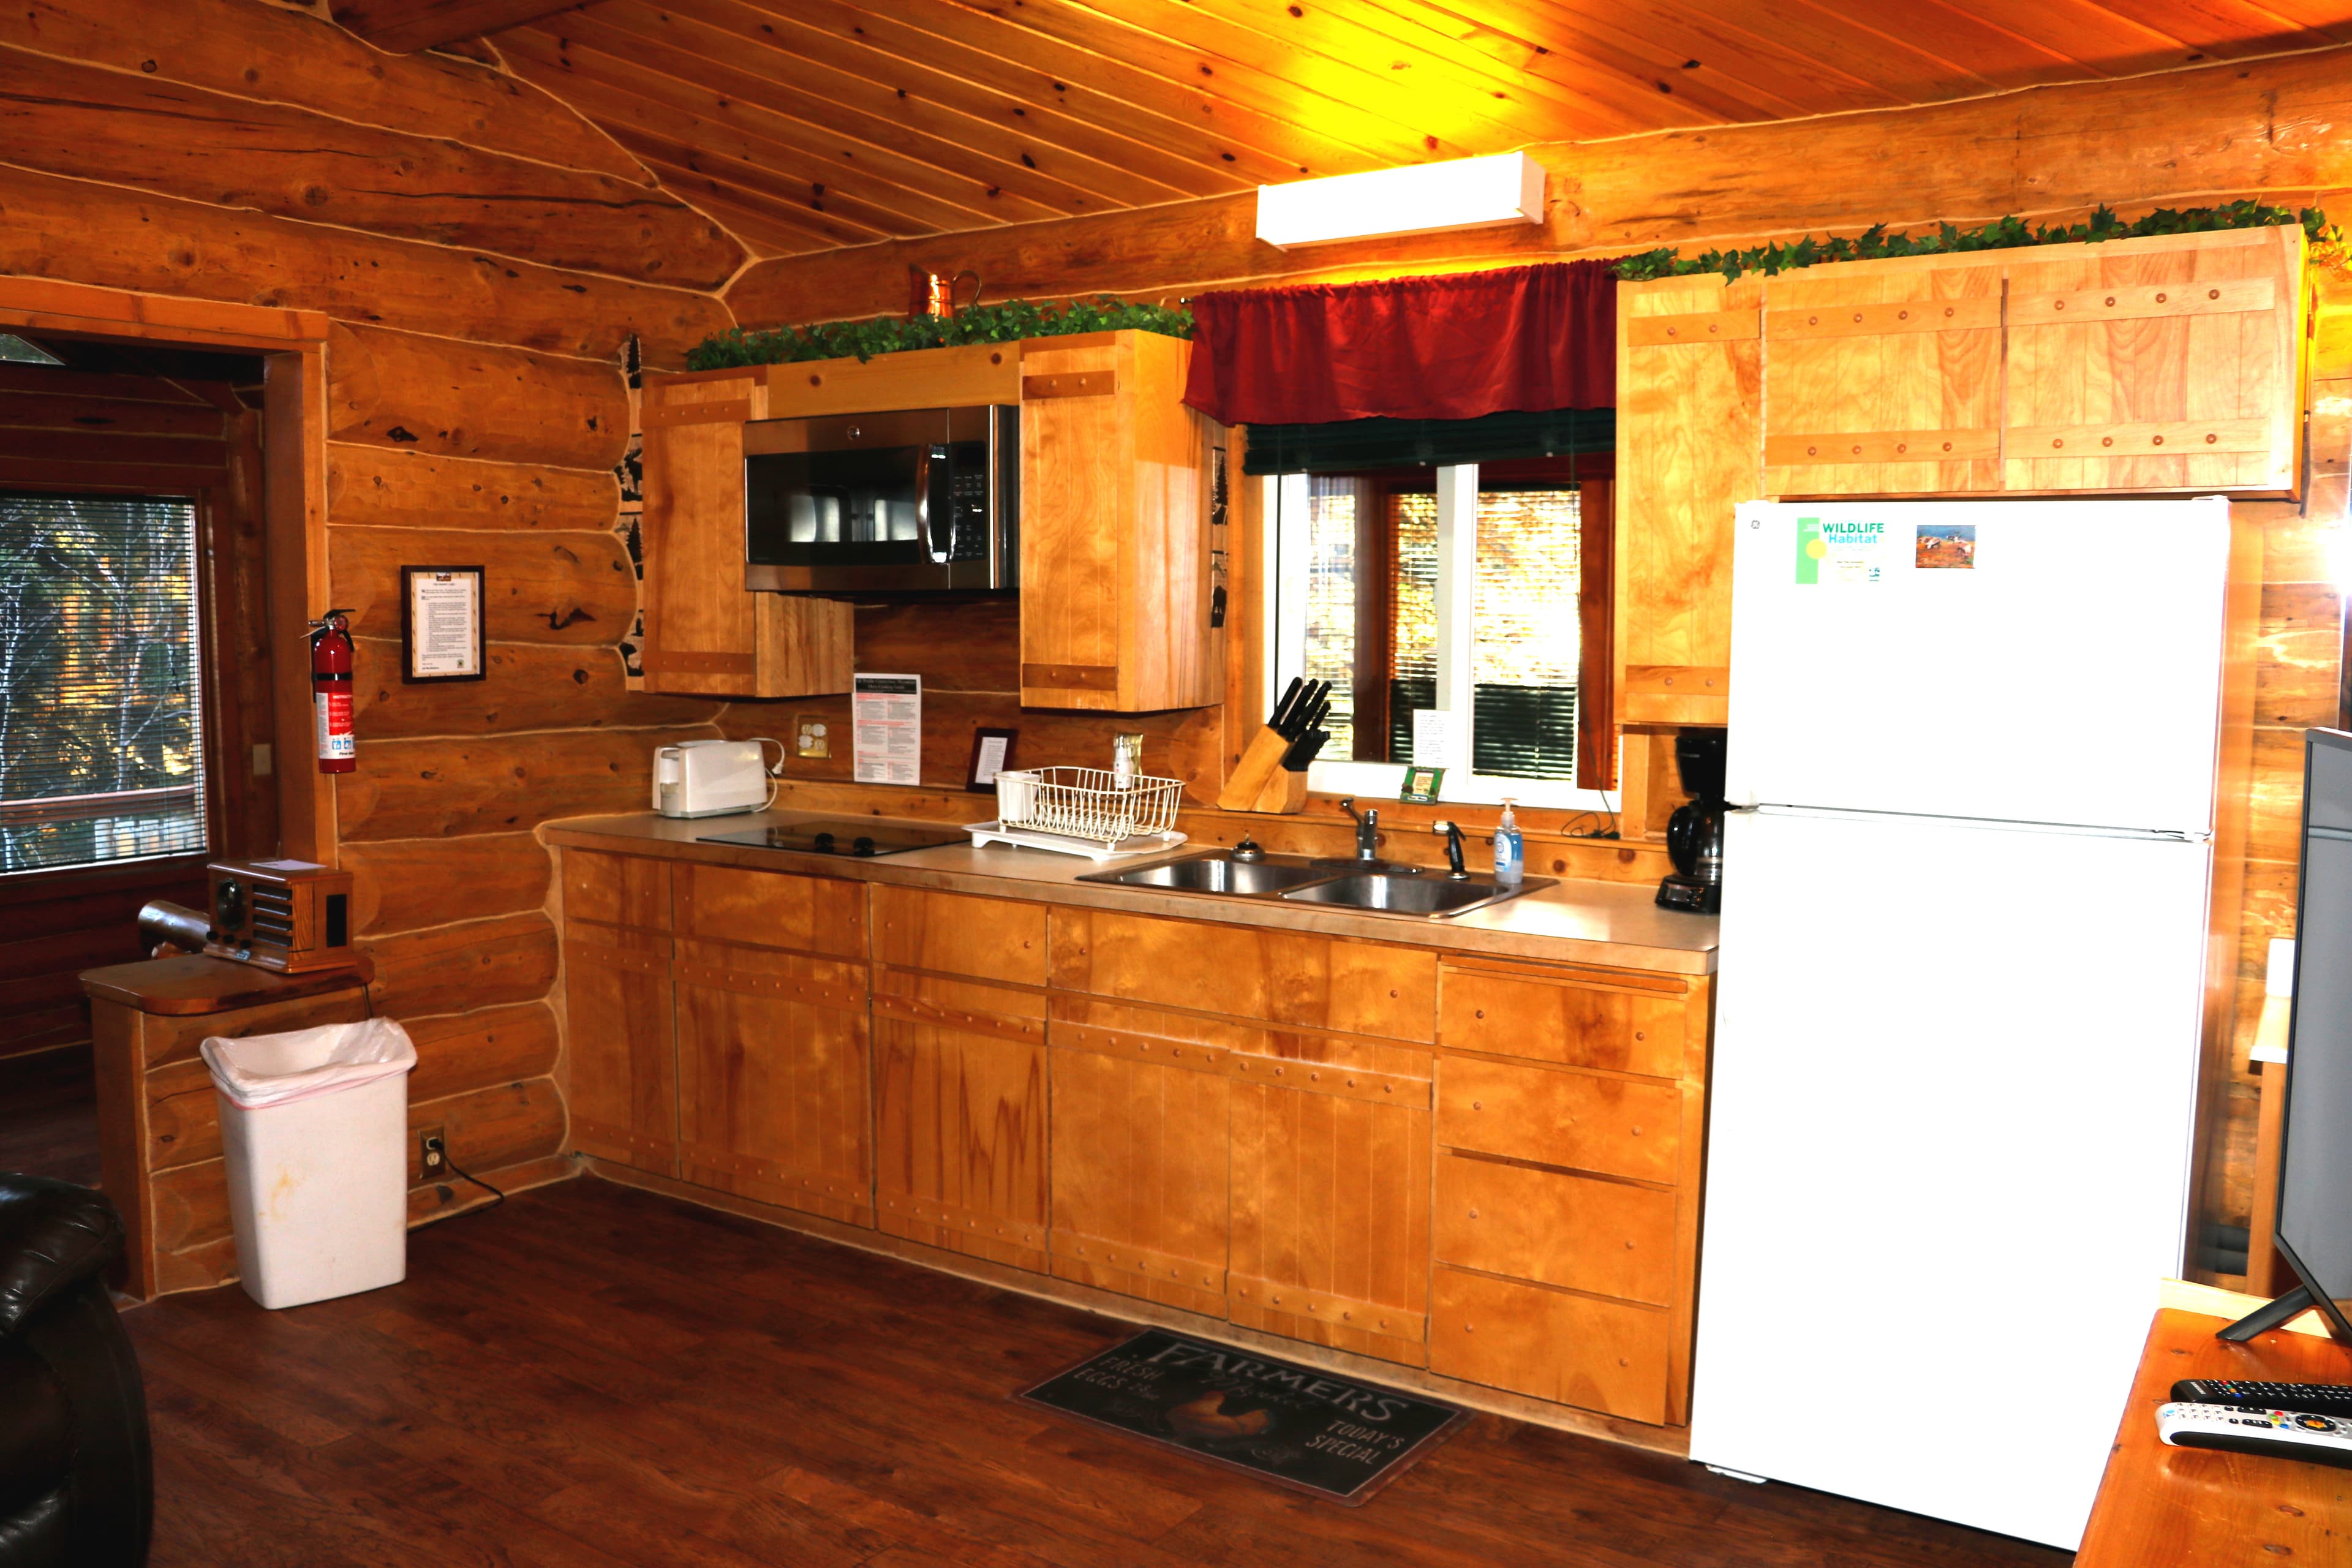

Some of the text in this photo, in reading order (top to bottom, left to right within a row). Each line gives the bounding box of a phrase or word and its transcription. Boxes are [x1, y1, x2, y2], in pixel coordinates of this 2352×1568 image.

[1823, 522, 1885, 533] WILDLIFE
[1829, 533, 1877, 544] Habitat
[1073, 1367, 1128, 1390] EGGS
[1098, 1355, 1166, 1381] FRESH
[1144, 1341, 1408, 1420] FARMERS
[1326, 1419, 1406, 1450] TODAY'S
[1305, 1434, 1382, 1465] SPECIAL
